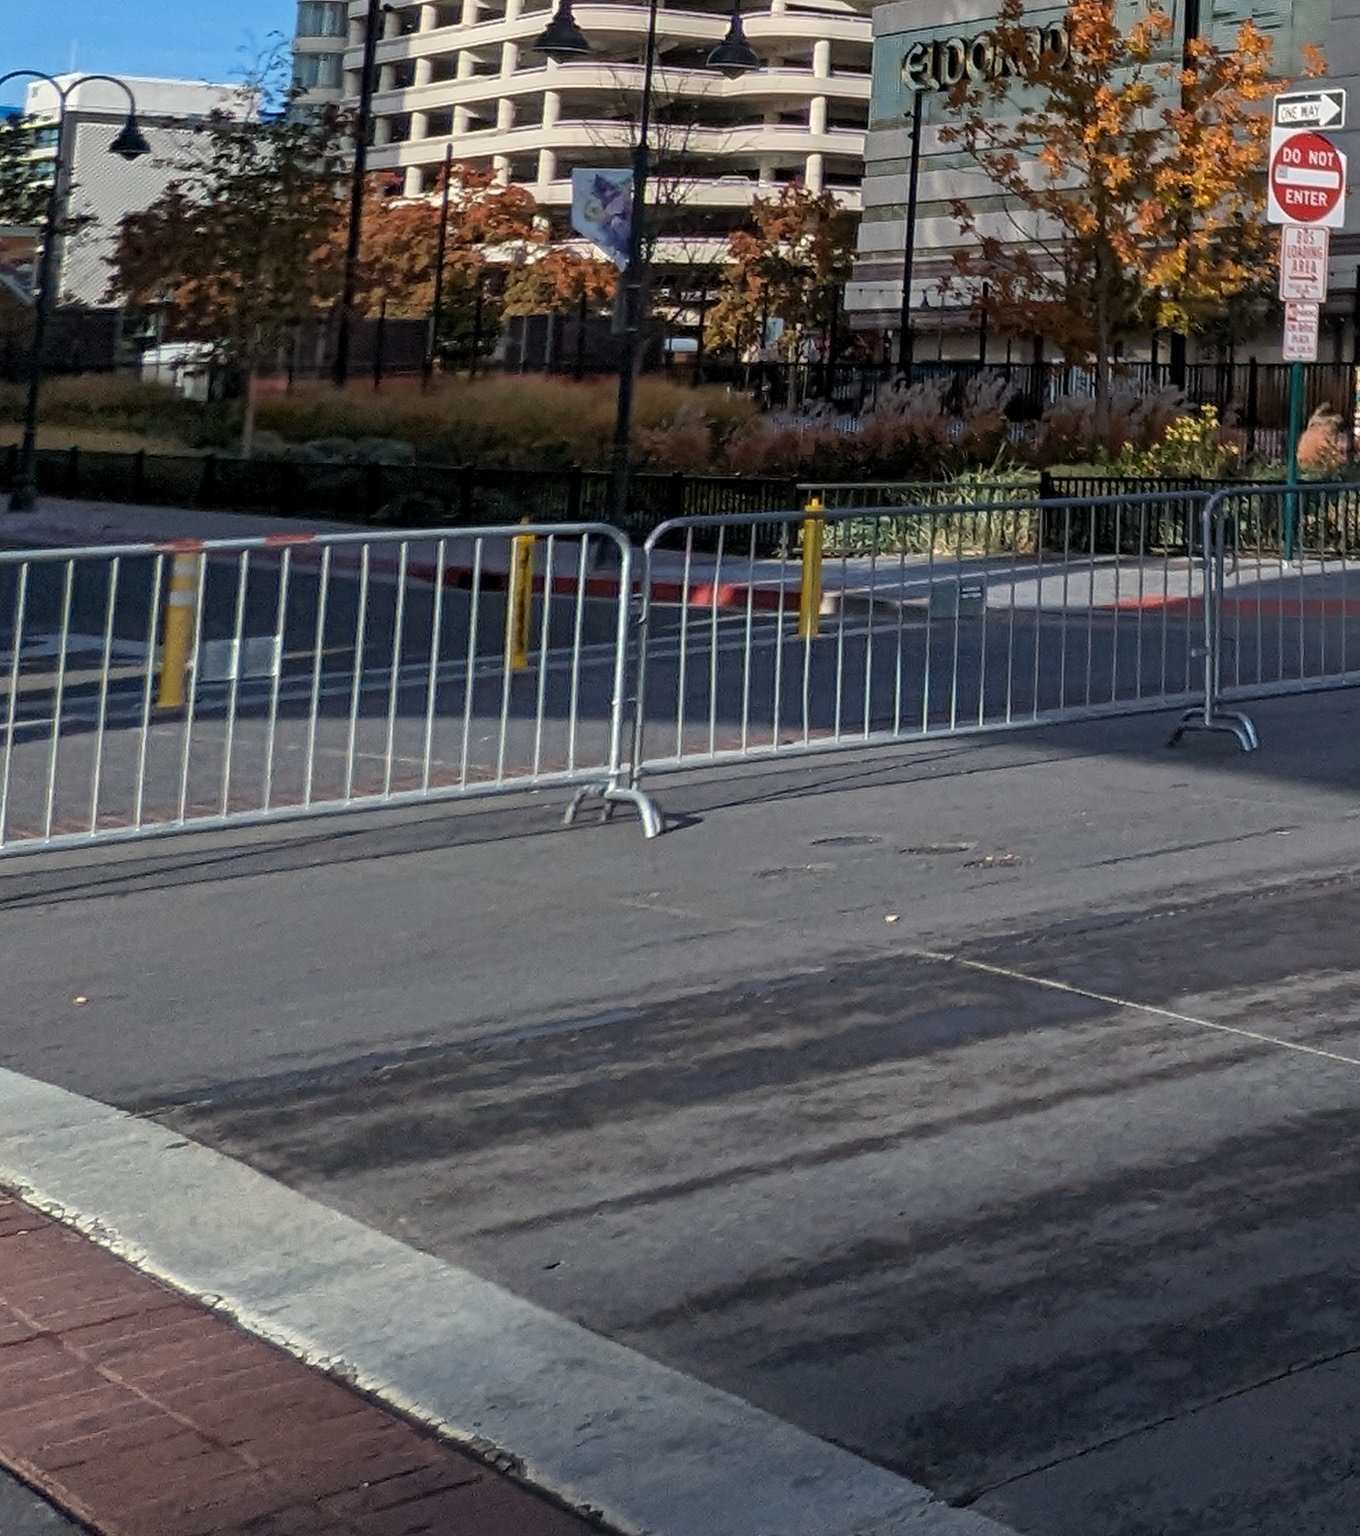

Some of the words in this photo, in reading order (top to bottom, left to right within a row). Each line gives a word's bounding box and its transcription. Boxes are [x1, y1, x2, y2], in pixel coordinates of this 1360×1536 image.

[1281, 106, 1298, 120] ONE
[1301, 105, 1319, 118] WAY
[1282, 146, 1301, 163] DO
[1308, 149, 1335, 166] NOT
[1285, 188, 1327, 207] ENTER
